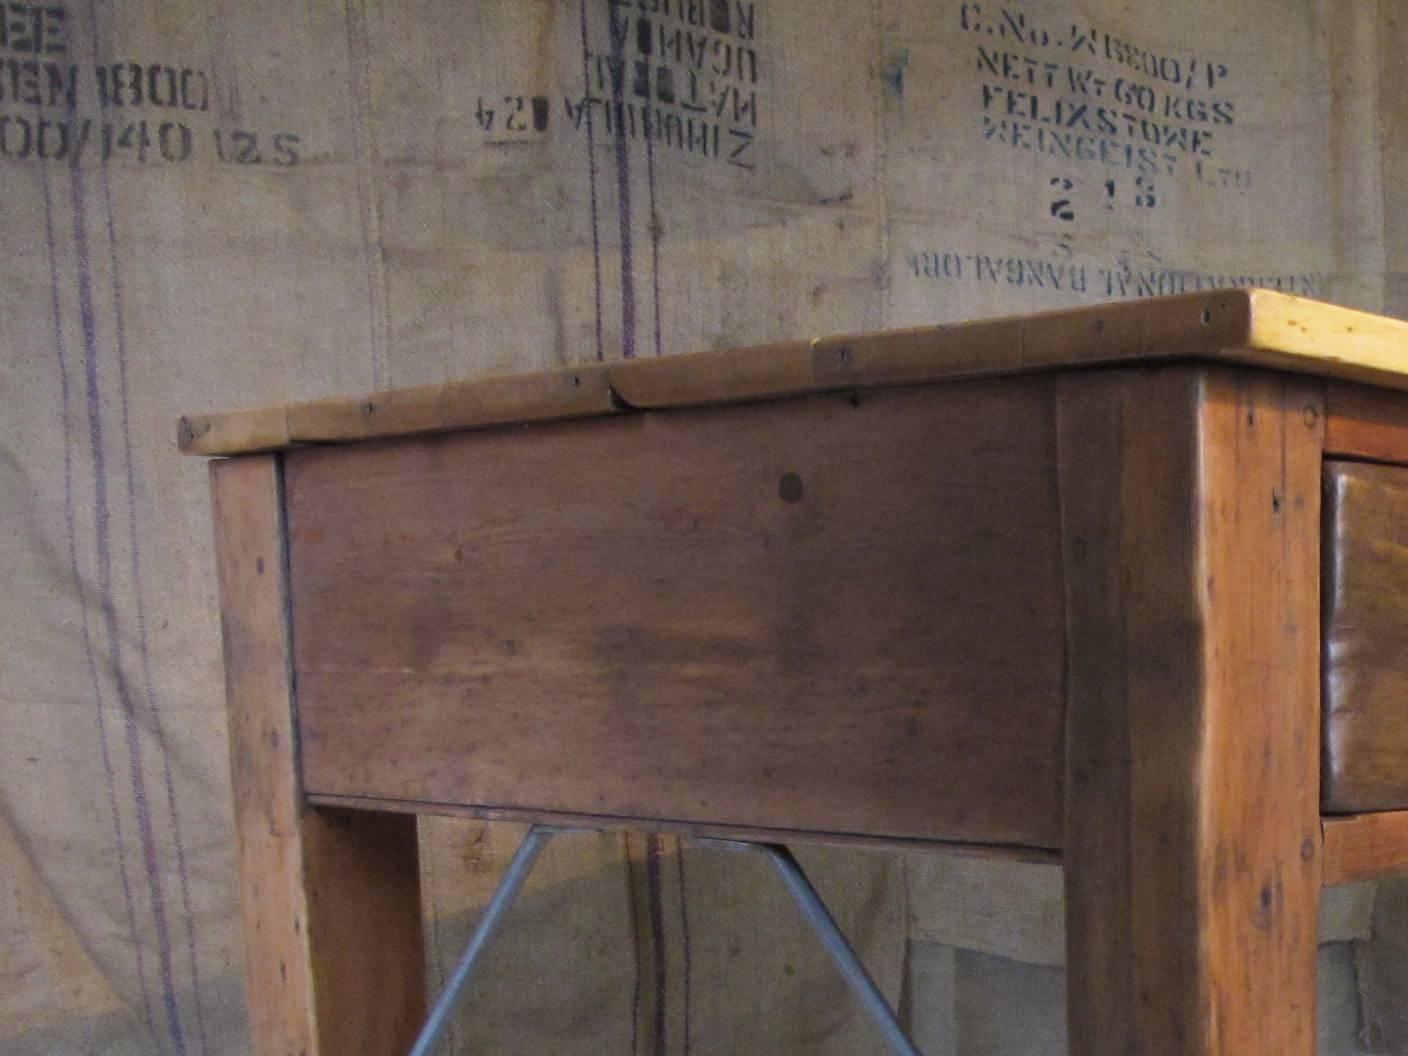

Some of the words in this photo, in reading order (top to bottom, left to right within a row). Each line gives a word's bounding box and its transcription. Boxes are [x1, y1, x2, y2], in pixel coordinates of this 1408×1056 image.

[977, 44, 1055, 89] NETT
[1165, 95, 1235, 127] KGS
[982, 83, 1213, 157] FELIXSTOWE
